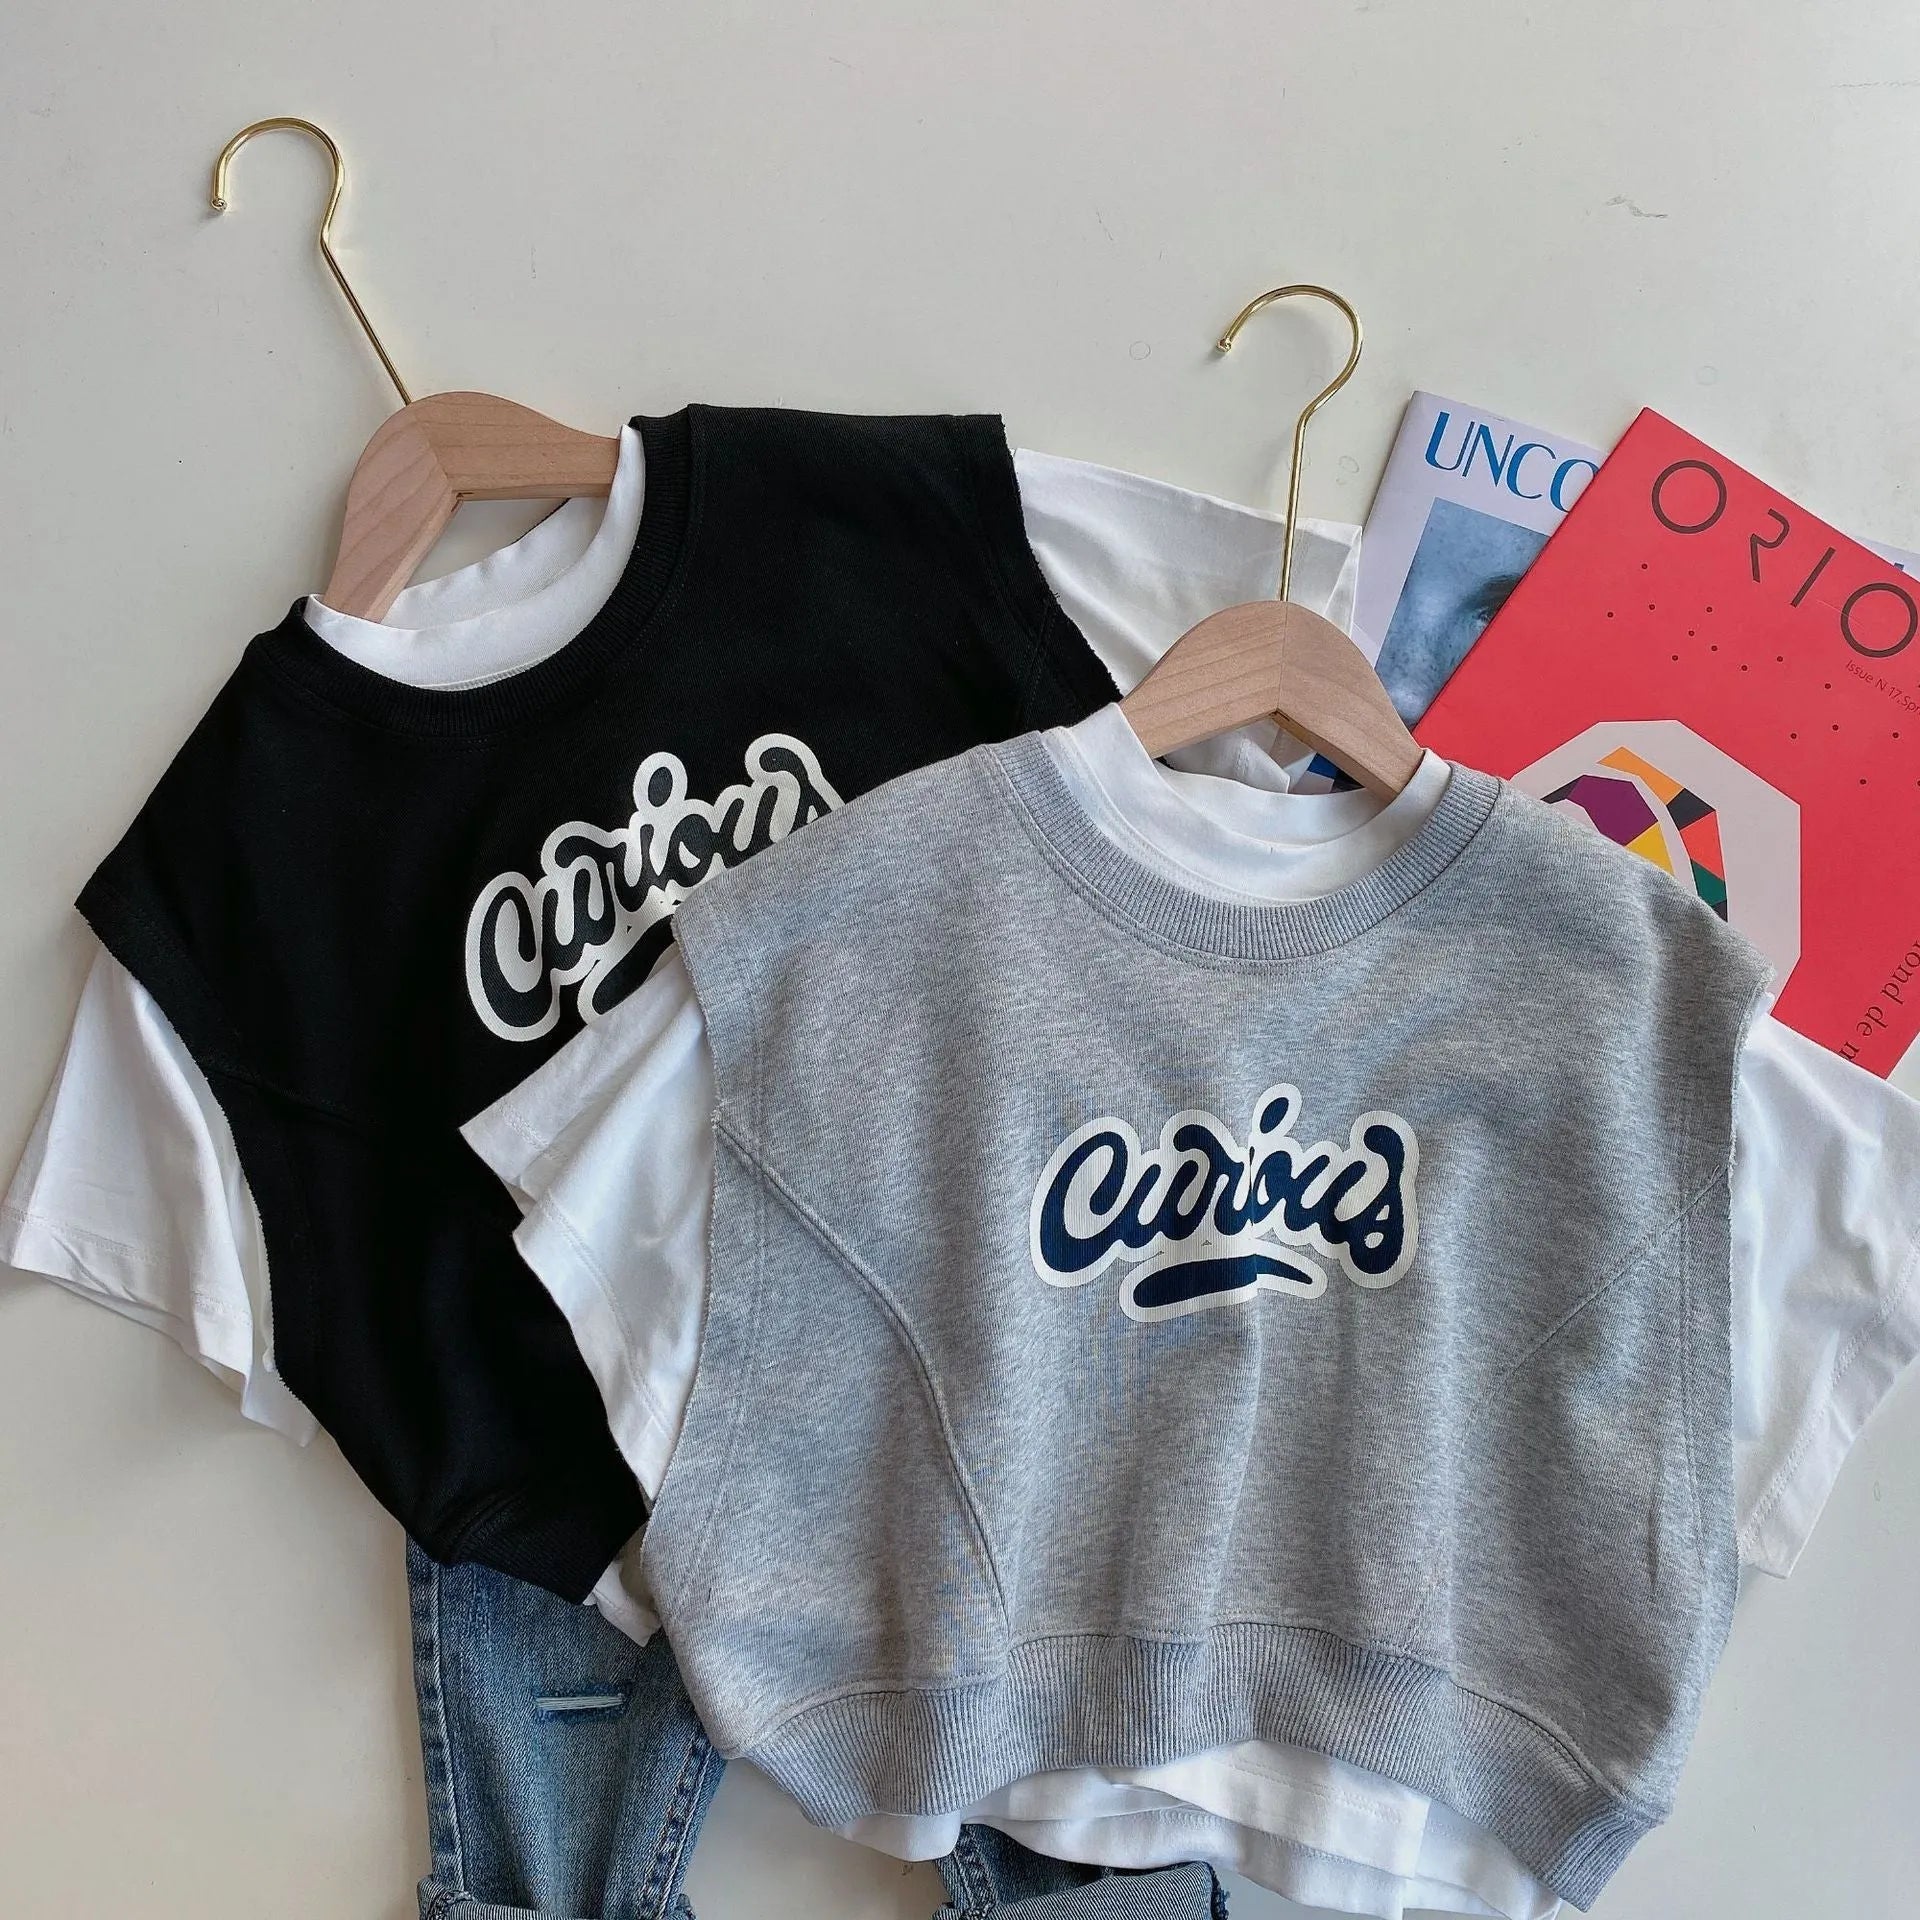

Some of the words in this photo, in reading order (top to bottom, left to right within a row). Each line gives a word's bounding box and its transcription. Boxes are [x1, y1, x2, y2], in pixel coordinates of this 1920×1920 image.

[1846, 659, 1874, 683] Issue
[1856, 1006, 1888, 1037] de
[1030, 1083, 1420, 1288] Curious
